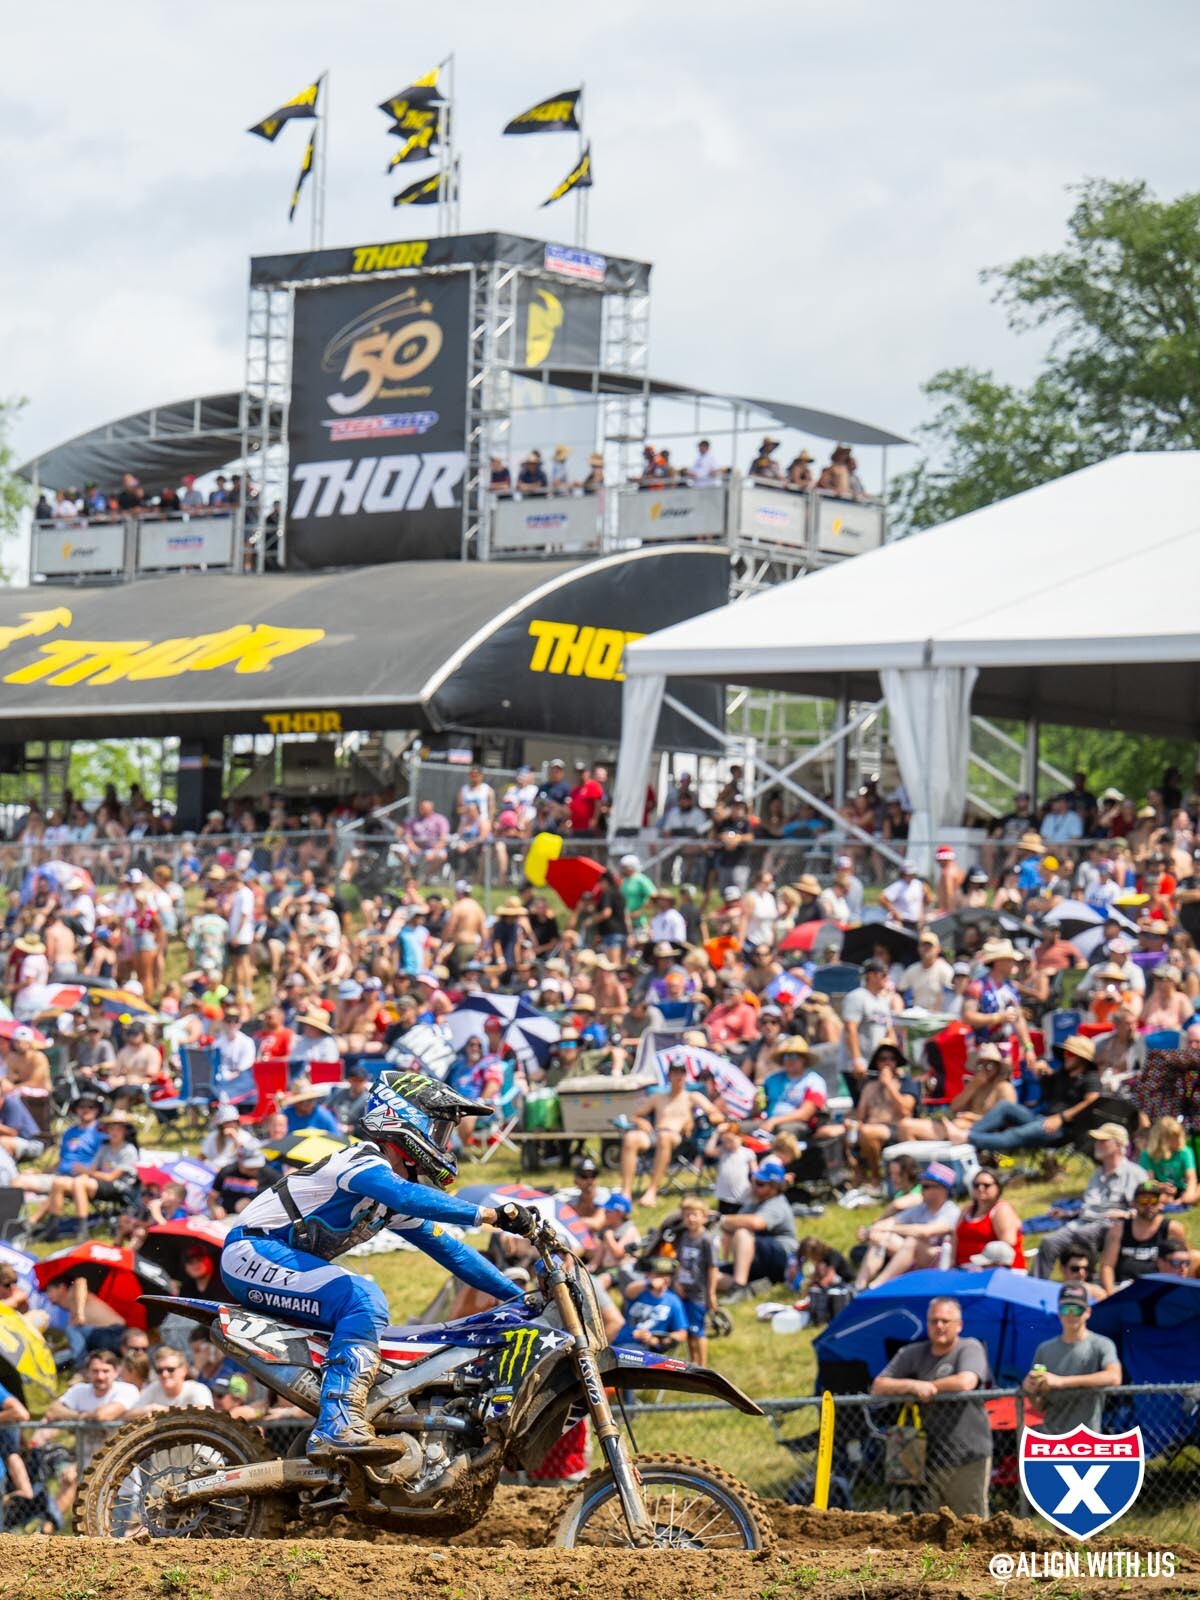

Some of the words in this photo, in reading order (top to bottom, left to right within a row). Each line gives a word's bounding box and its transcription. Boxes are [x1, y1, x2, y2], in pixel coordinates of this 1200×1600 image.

[352, 241, 428, 272] THOR
[326, 319, 444, 415] 50
[290, 451, 468, 520] THOR
[3, 623, 325, 687] THOR
[262, 711, 342, 734] THOR
[263, 1292, 321, 1317] YAMAHA
